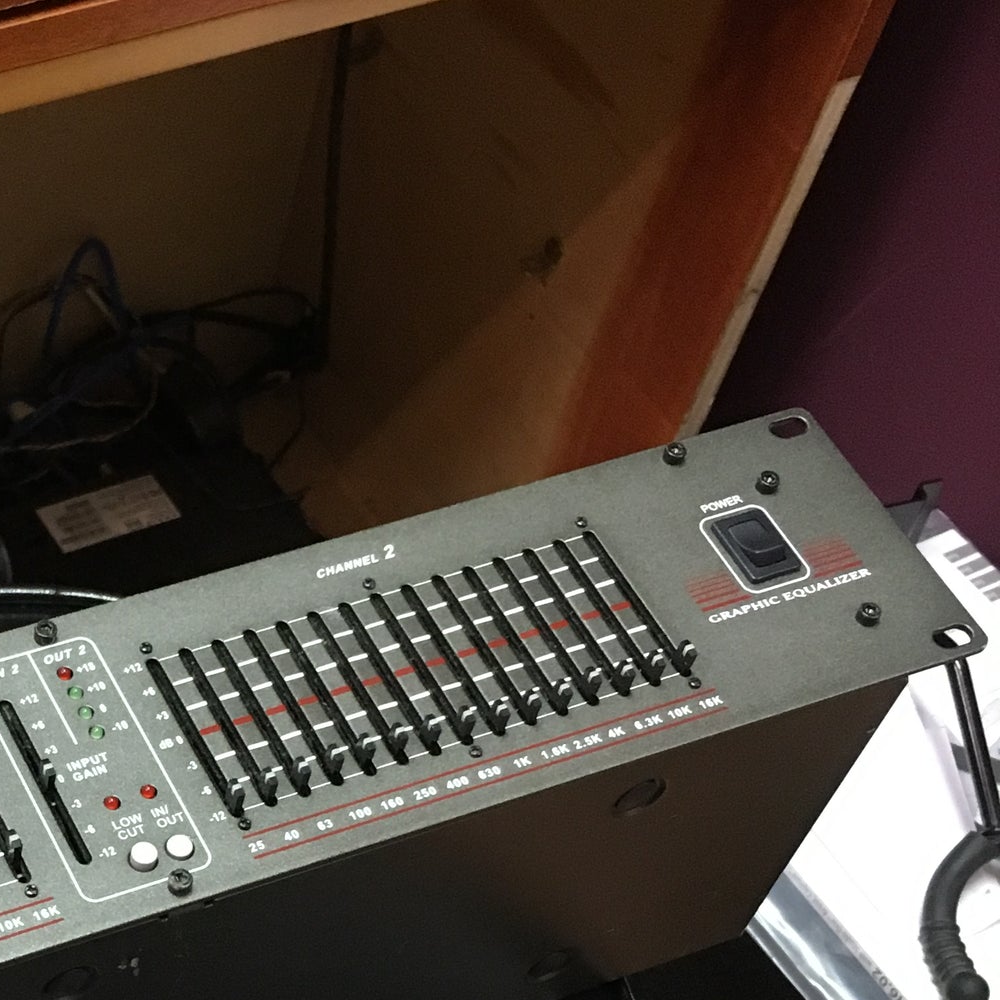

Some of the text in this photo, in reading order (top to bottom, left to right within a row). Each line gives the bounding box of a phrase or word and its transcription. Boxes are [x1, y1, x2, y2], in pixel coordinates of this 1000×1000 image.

[700, 495, 744, 514] POWER
[317, 544, 395, 578] CHANNEL 2
[709, 568, 871, 623] GRAPHIC EQUALIZER
[43, 645, 86, 664] OUT 2
[12, 664, 19, 674] 2
[124, 663, 143, 673] +12
[20, 694, 39, 704] +12
[156, 711, 169, 720] +3
[45, 745, 58, 754] +3
[159, 738, 174, 749] dB
[66, 752, 107, 772] INPUT
[187, 761, 197, 769] -3
[57, 774, 64, 783] 0
[72, 764, 107, 781] GAIN
[248, 696, 723, 853] 25 40 63 100 160 250 400 630 1K 1.6K 2.5K 4K 6.3K 10K 16K
[72, 799, 82, 808] -3
[151, 805, 170, 819] IN/
[210, 811, 227, 821] -12
[111, 813, 144, 831] LOW
[156, 812, 183, 827] OUT
[117, 824, 144, 840] CUT
[99, 846, 117, 857] -12
[33, 905, 60, 920] 16K
